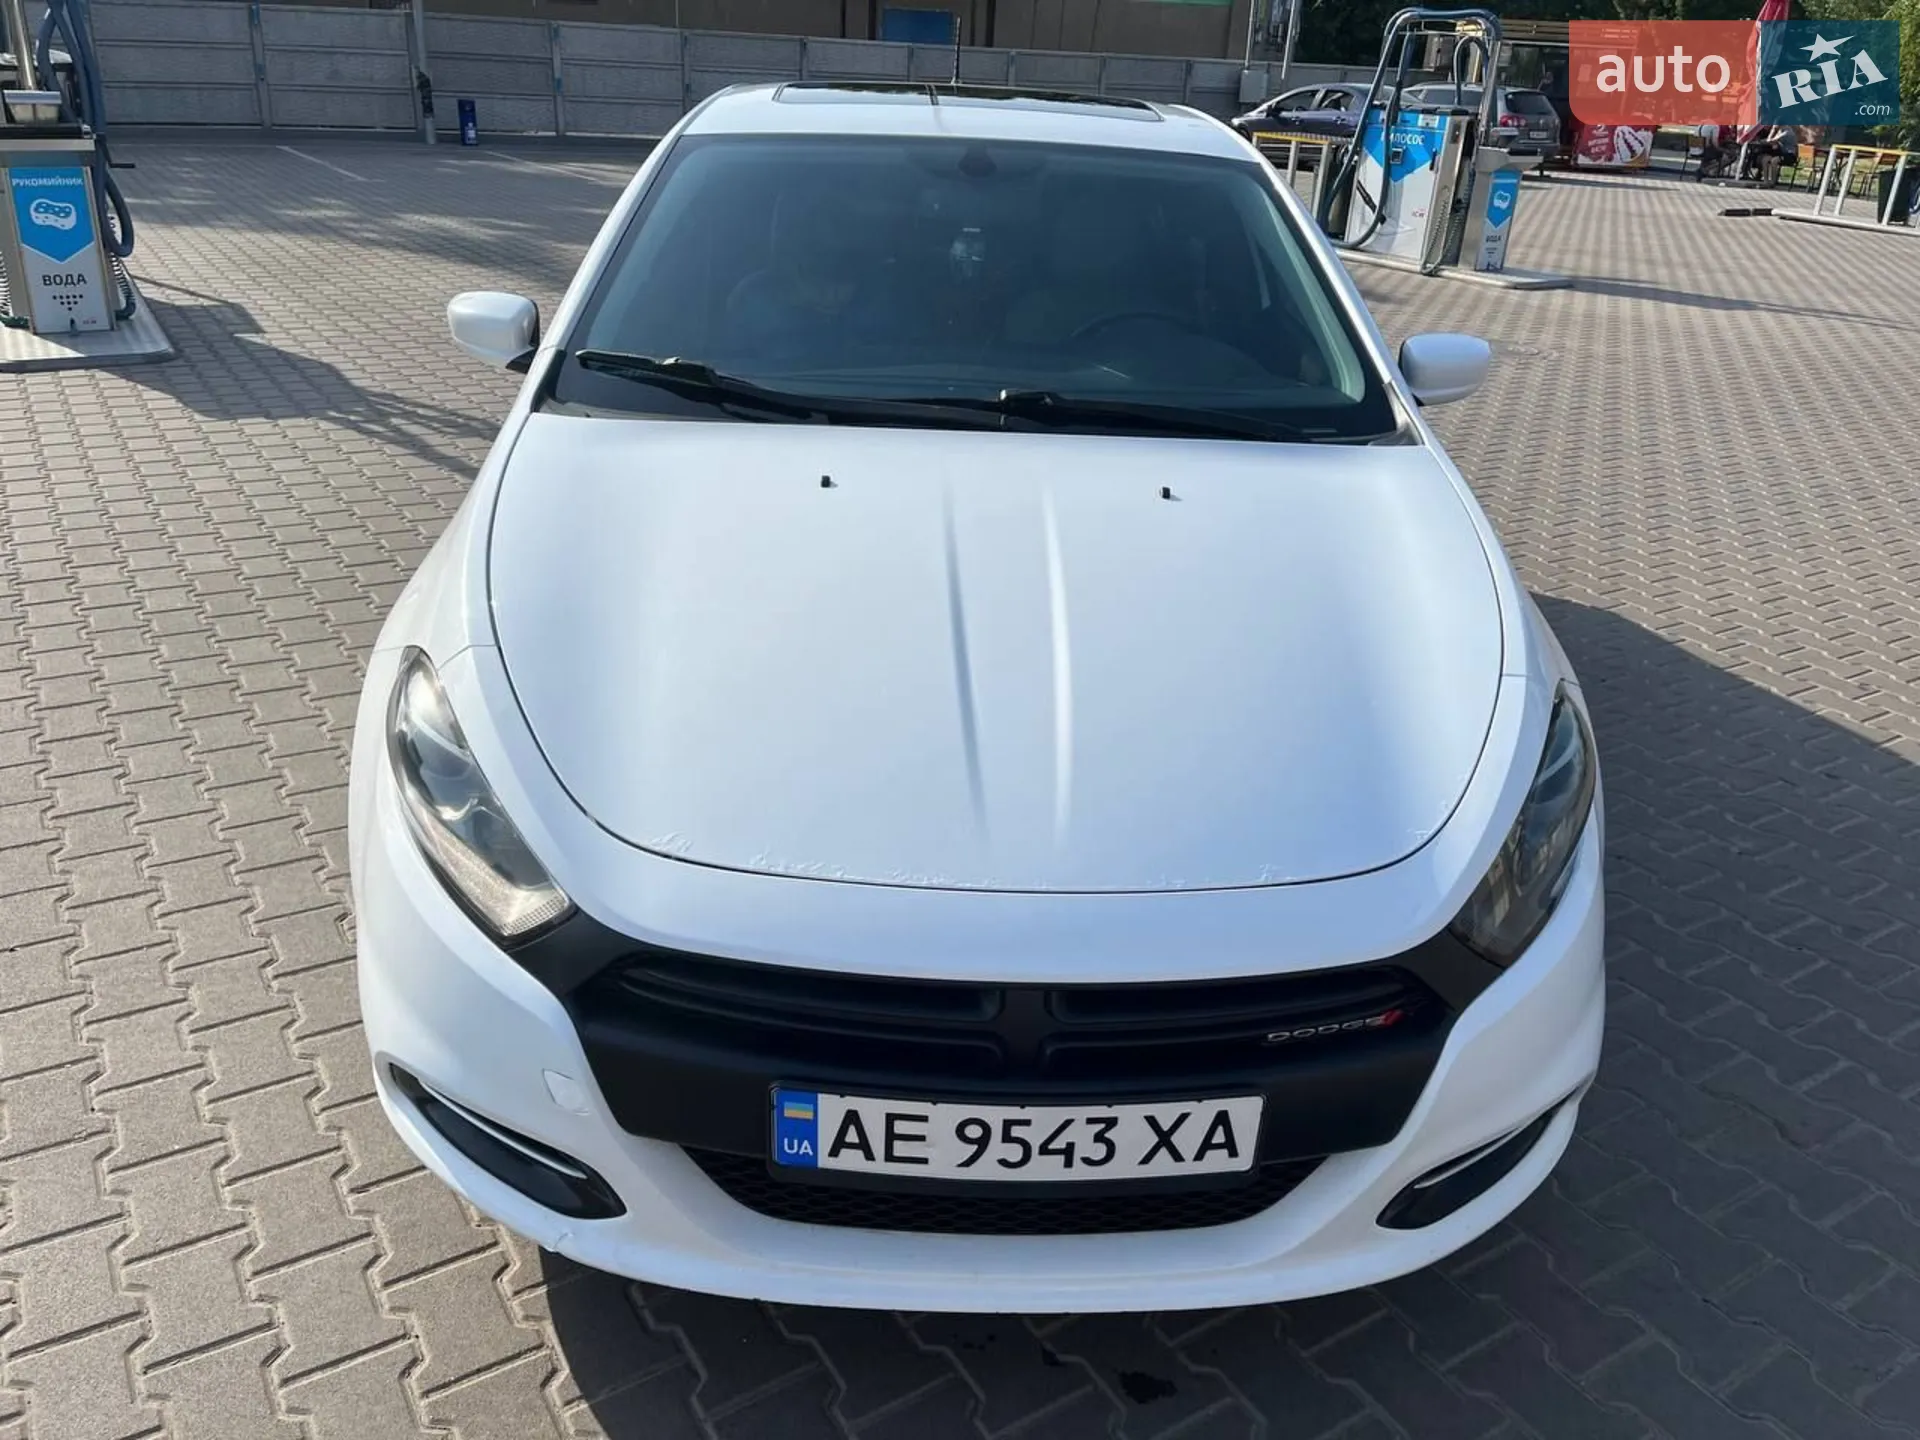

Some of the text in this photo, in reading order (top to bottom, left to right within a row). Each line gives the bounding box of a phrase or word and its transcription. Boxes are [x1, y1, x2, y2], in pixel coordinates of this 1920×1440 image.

[11, 175, 84, 187] РУКОМИЙНИК
[42, 273, 87, 287] ВОДА
[1267, 1016, 1382, 1041] DODGE
[783, 1138, 814, 1156] UA
[827, 1109, 1240, 1169] AE 9543 XA
